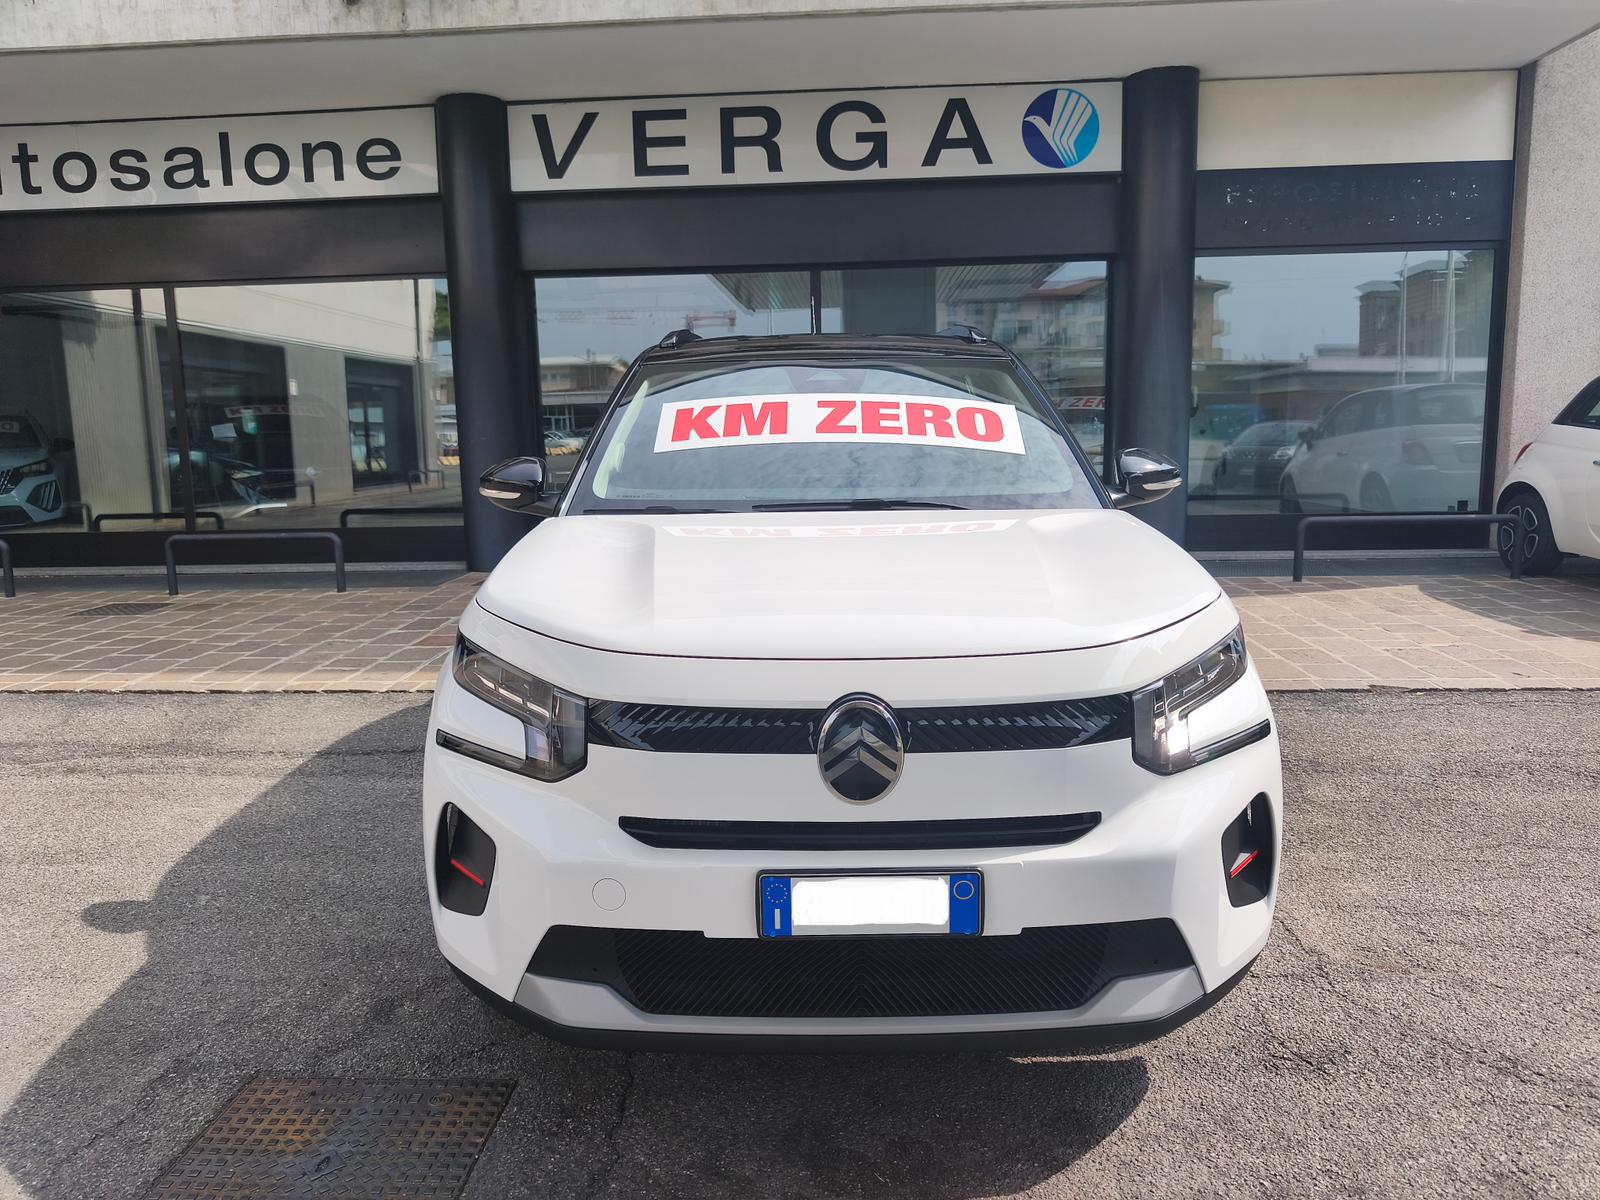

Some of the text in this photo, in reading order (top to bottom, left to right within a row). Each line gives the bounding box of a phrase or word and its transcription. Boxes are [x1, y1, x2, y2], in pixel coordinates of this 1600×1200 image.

[0, 132, 402, 195] tosalone
[532, 98, 994, 180] VERGA
[672, 401, 1005, 443] KM ZERO
